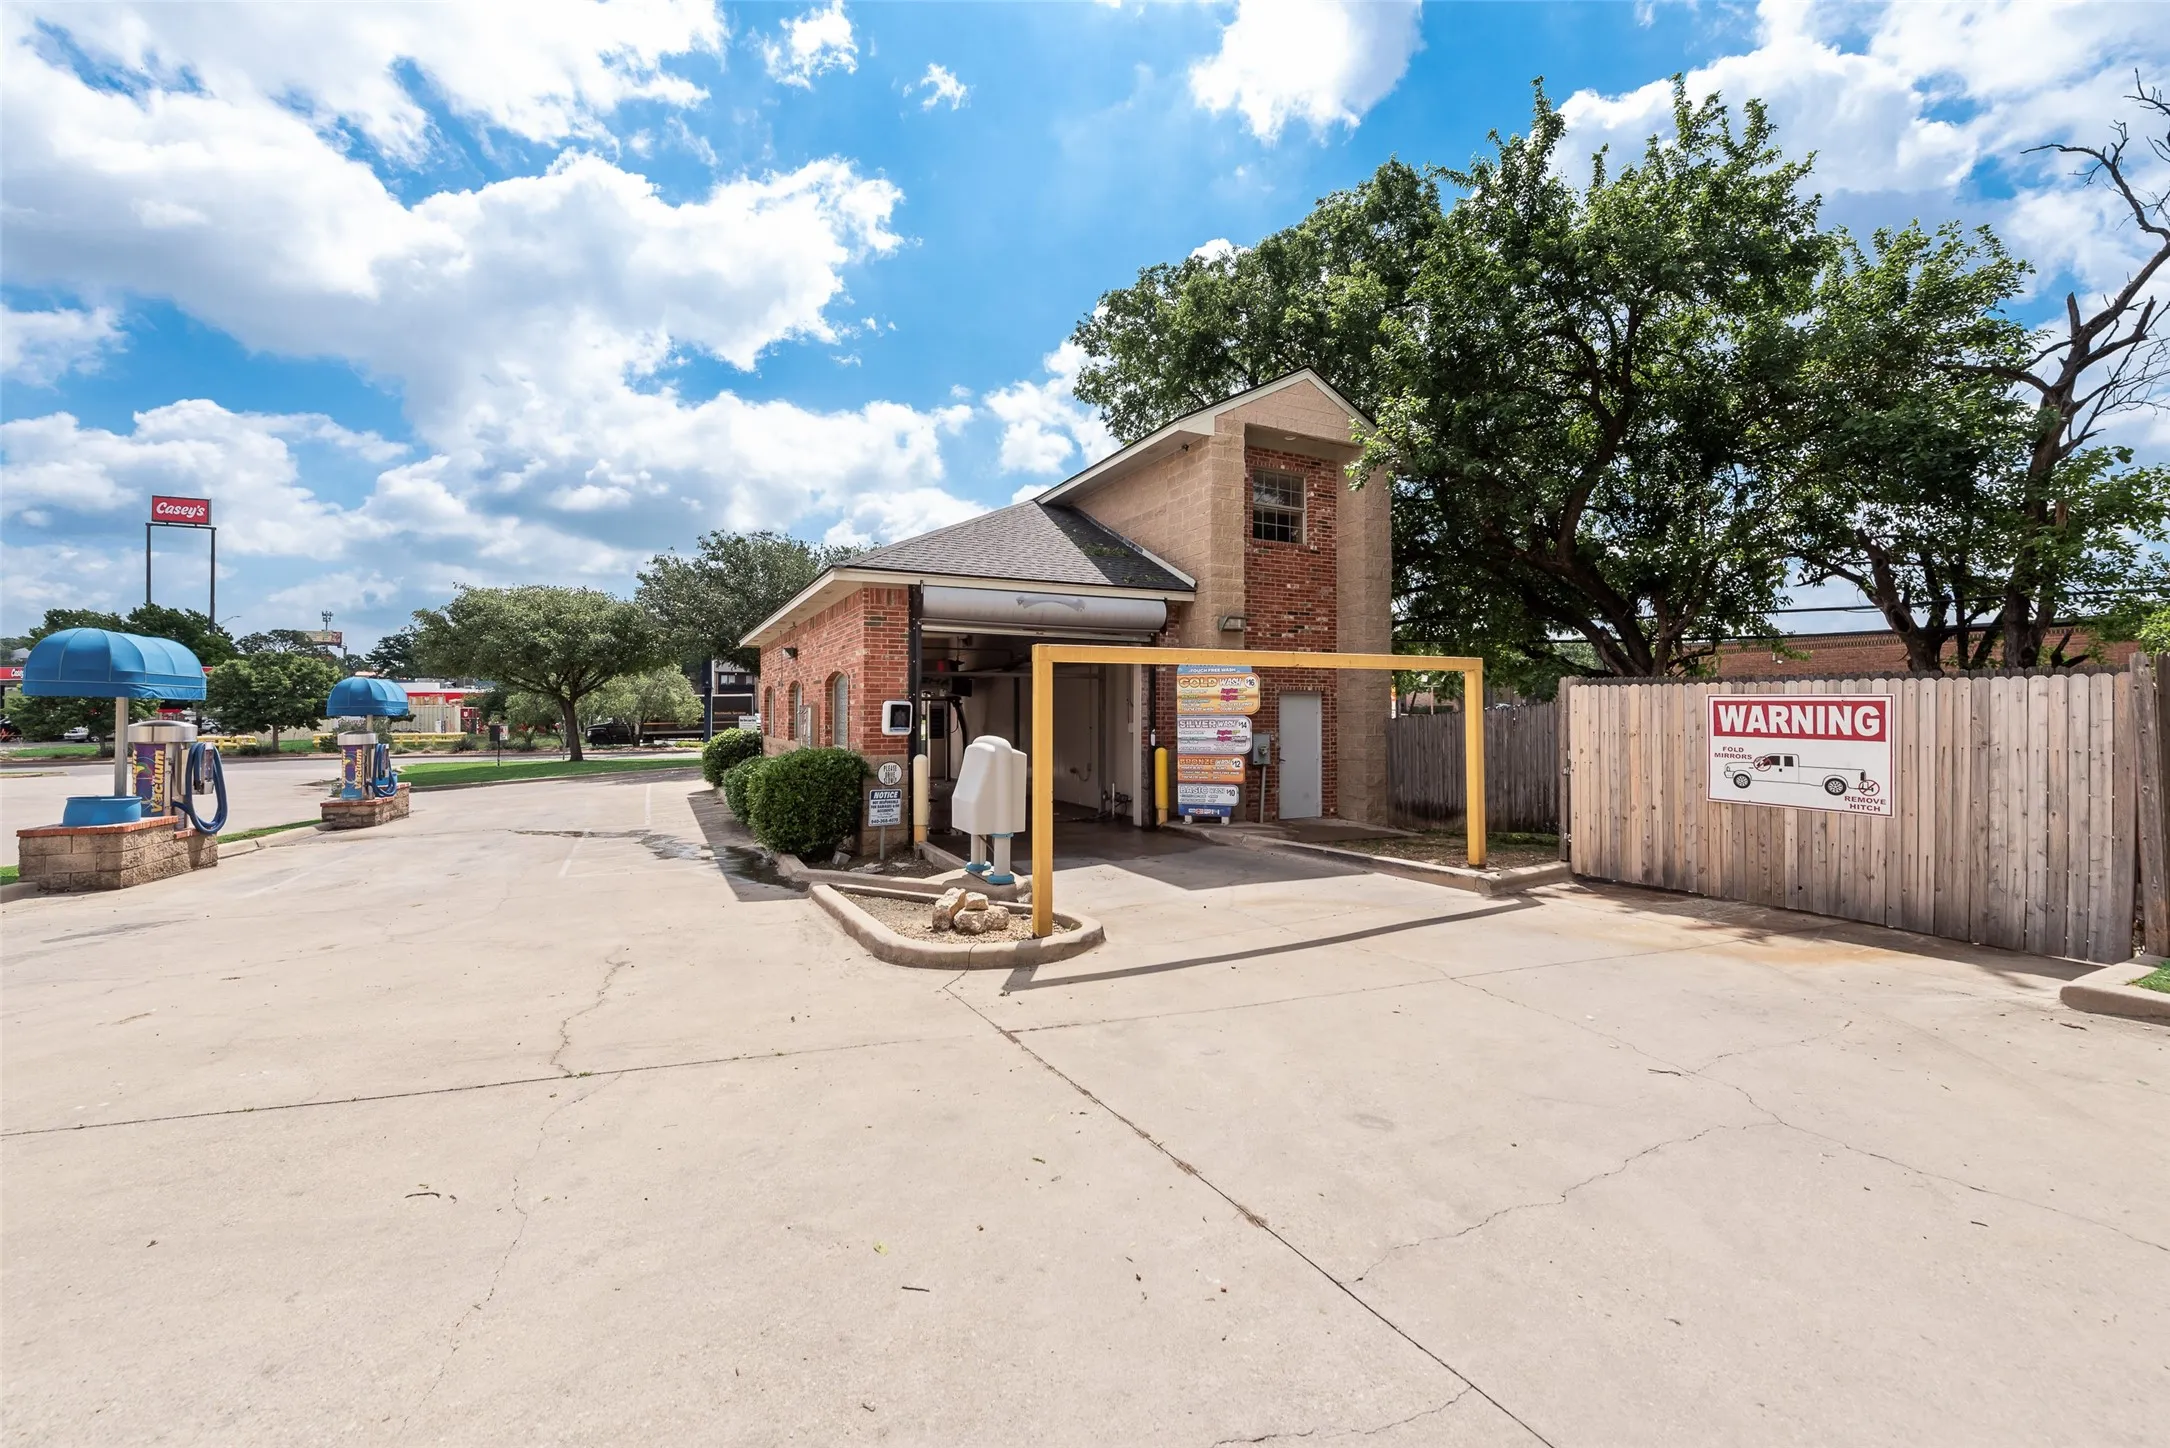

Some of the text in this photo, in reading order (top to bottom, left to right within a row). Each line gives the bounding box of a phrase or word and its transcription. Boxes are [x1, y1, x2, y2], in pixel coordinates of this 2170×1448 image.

[156, 502, 205, 518] Casey's
[1179, 676, 1255, 688] GOLD WASH $16
[1179, 719, 1247, 729] SILVER WASH $14
[1717, 704, 1881, 737] WARNING
[1714, 752, 1753, 760] MIRRORS
[1231, 760, 1241, 768] $12
[873, 791, 899, 799] NOTICE
[1180, 785, 1209, 794] BASIC
[1226, 789, 1236, 797] $10
[1844, 795, 1887, 805] REMOVE
[1849, 803, 1881, 812] HITCH
